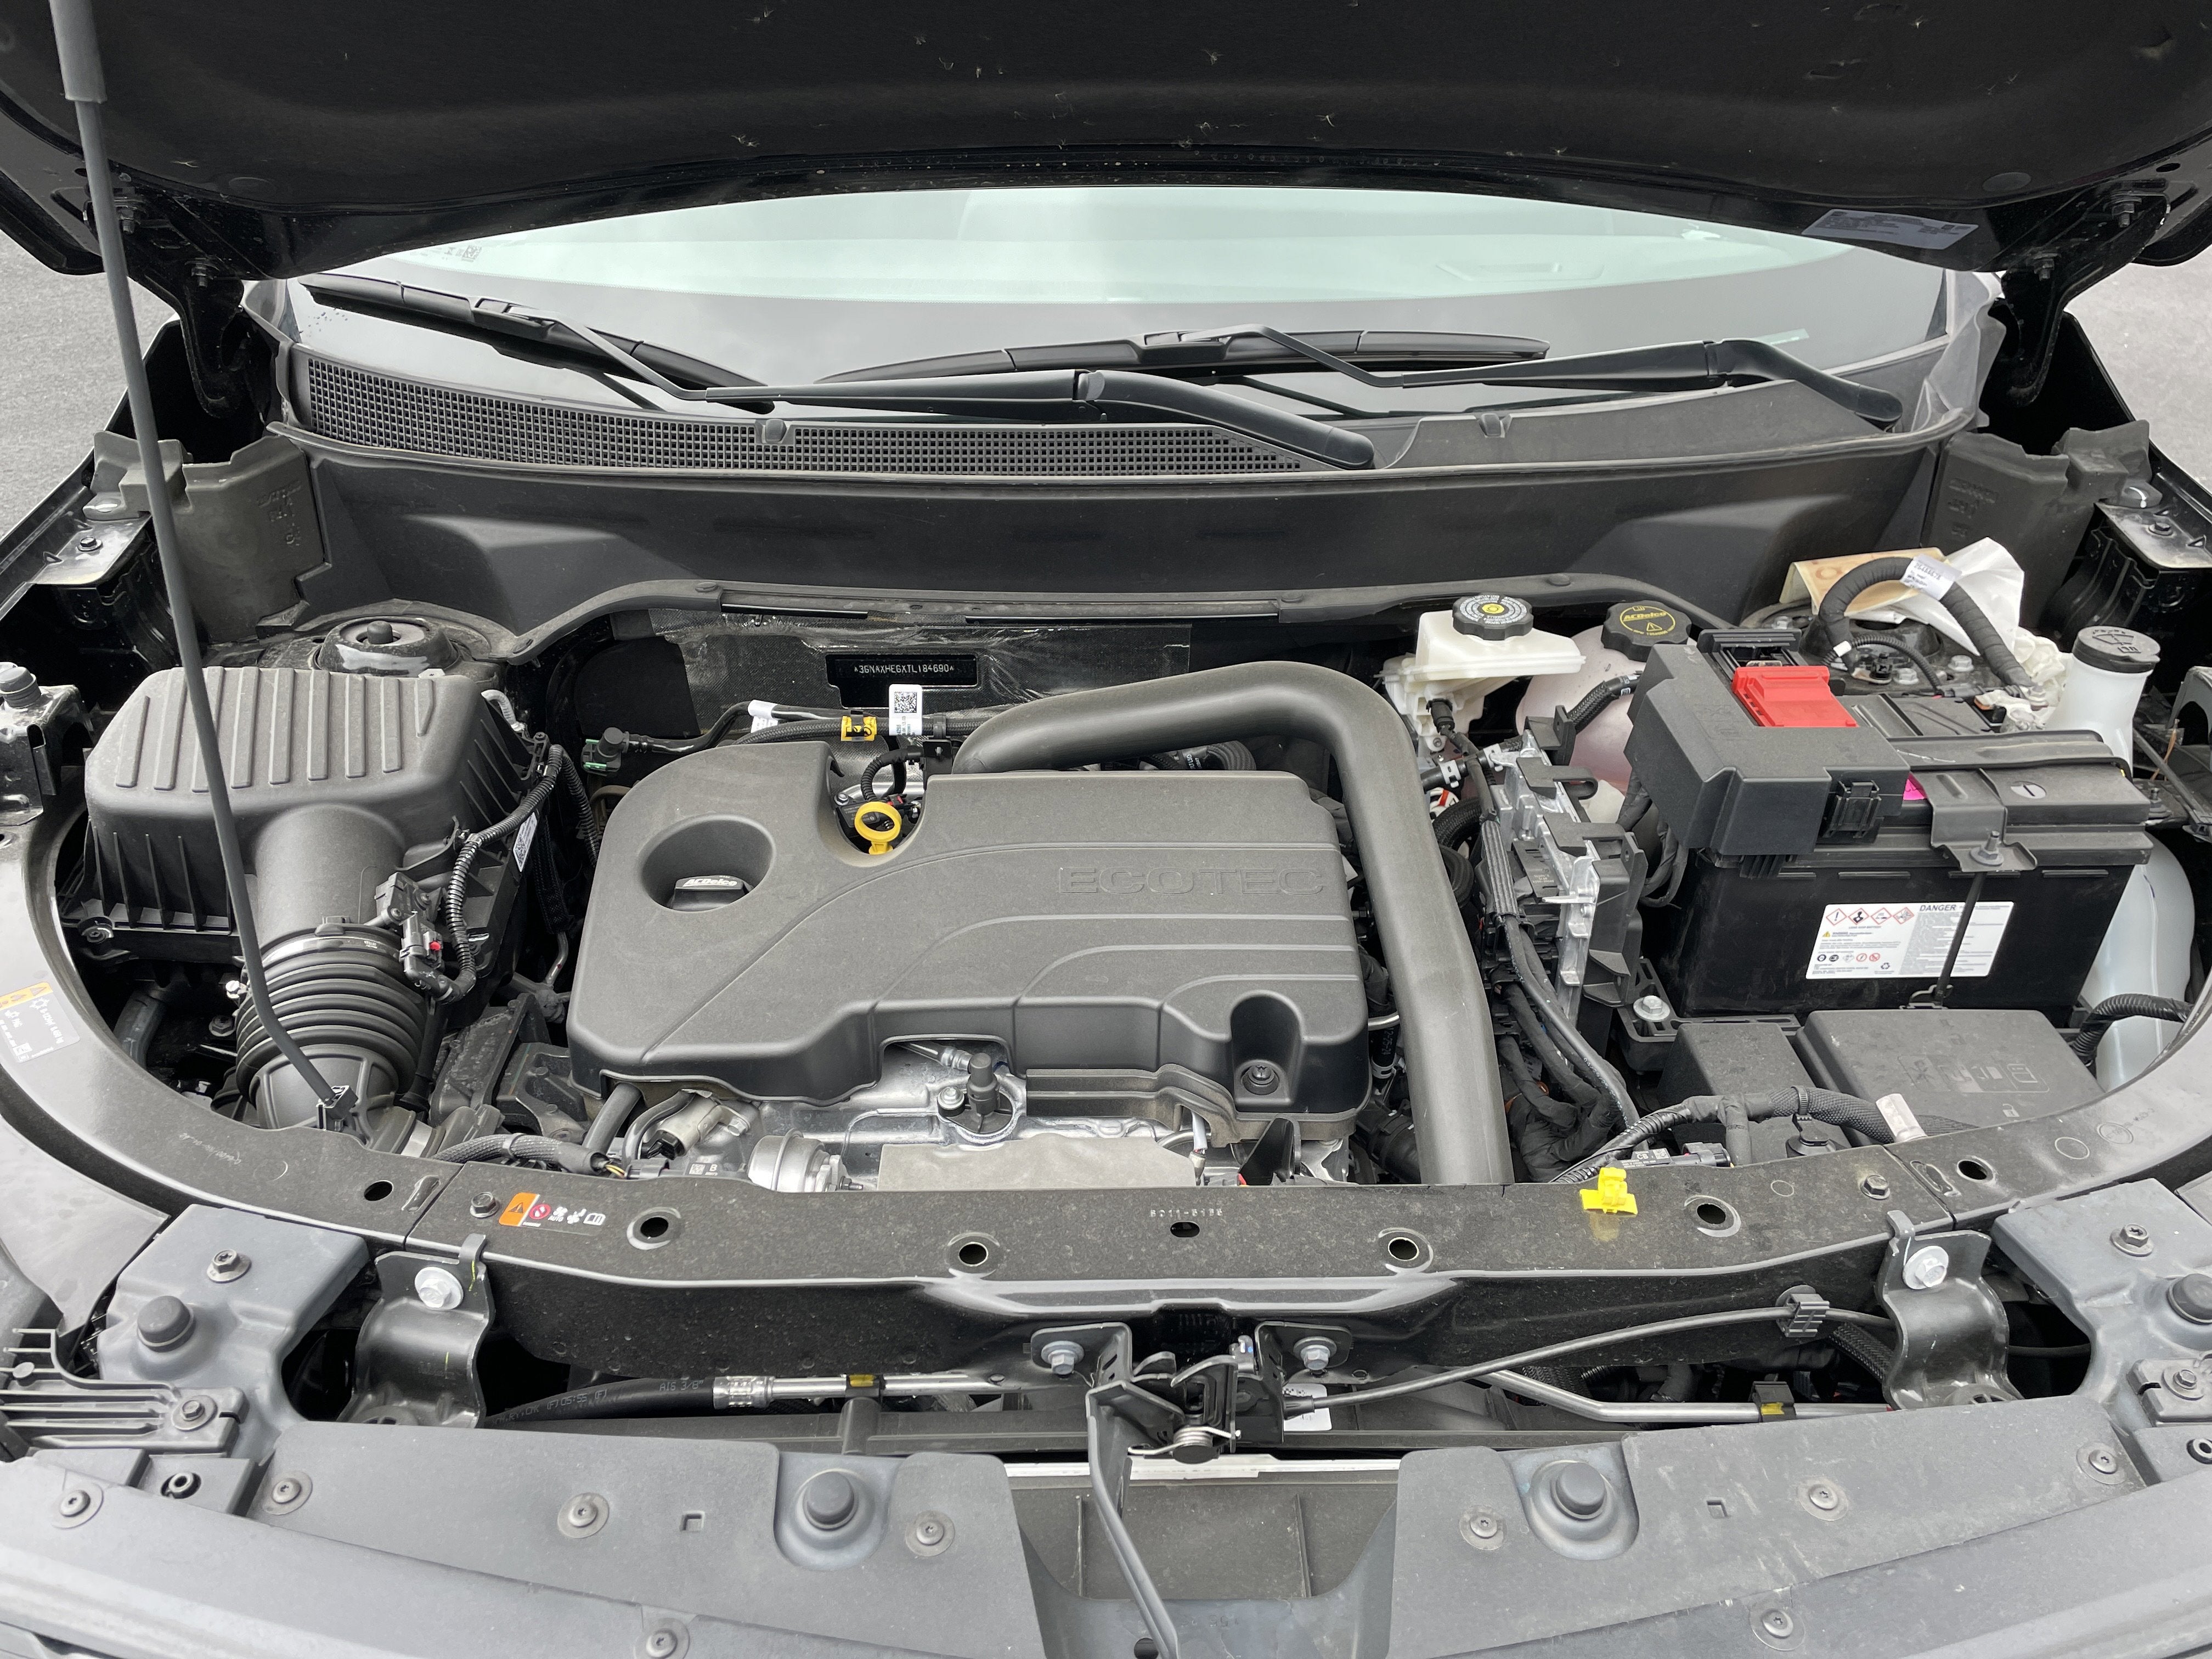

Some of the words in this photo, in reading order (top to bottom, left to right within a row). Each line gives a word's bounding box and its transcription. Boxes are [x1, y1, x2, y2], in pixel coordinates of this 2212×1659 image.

[1623, 612, 1667, 622] ACDelco
[682, 878, 738, 887] ACDelco
[1058, 867, 1324, 895] ECOTEC
